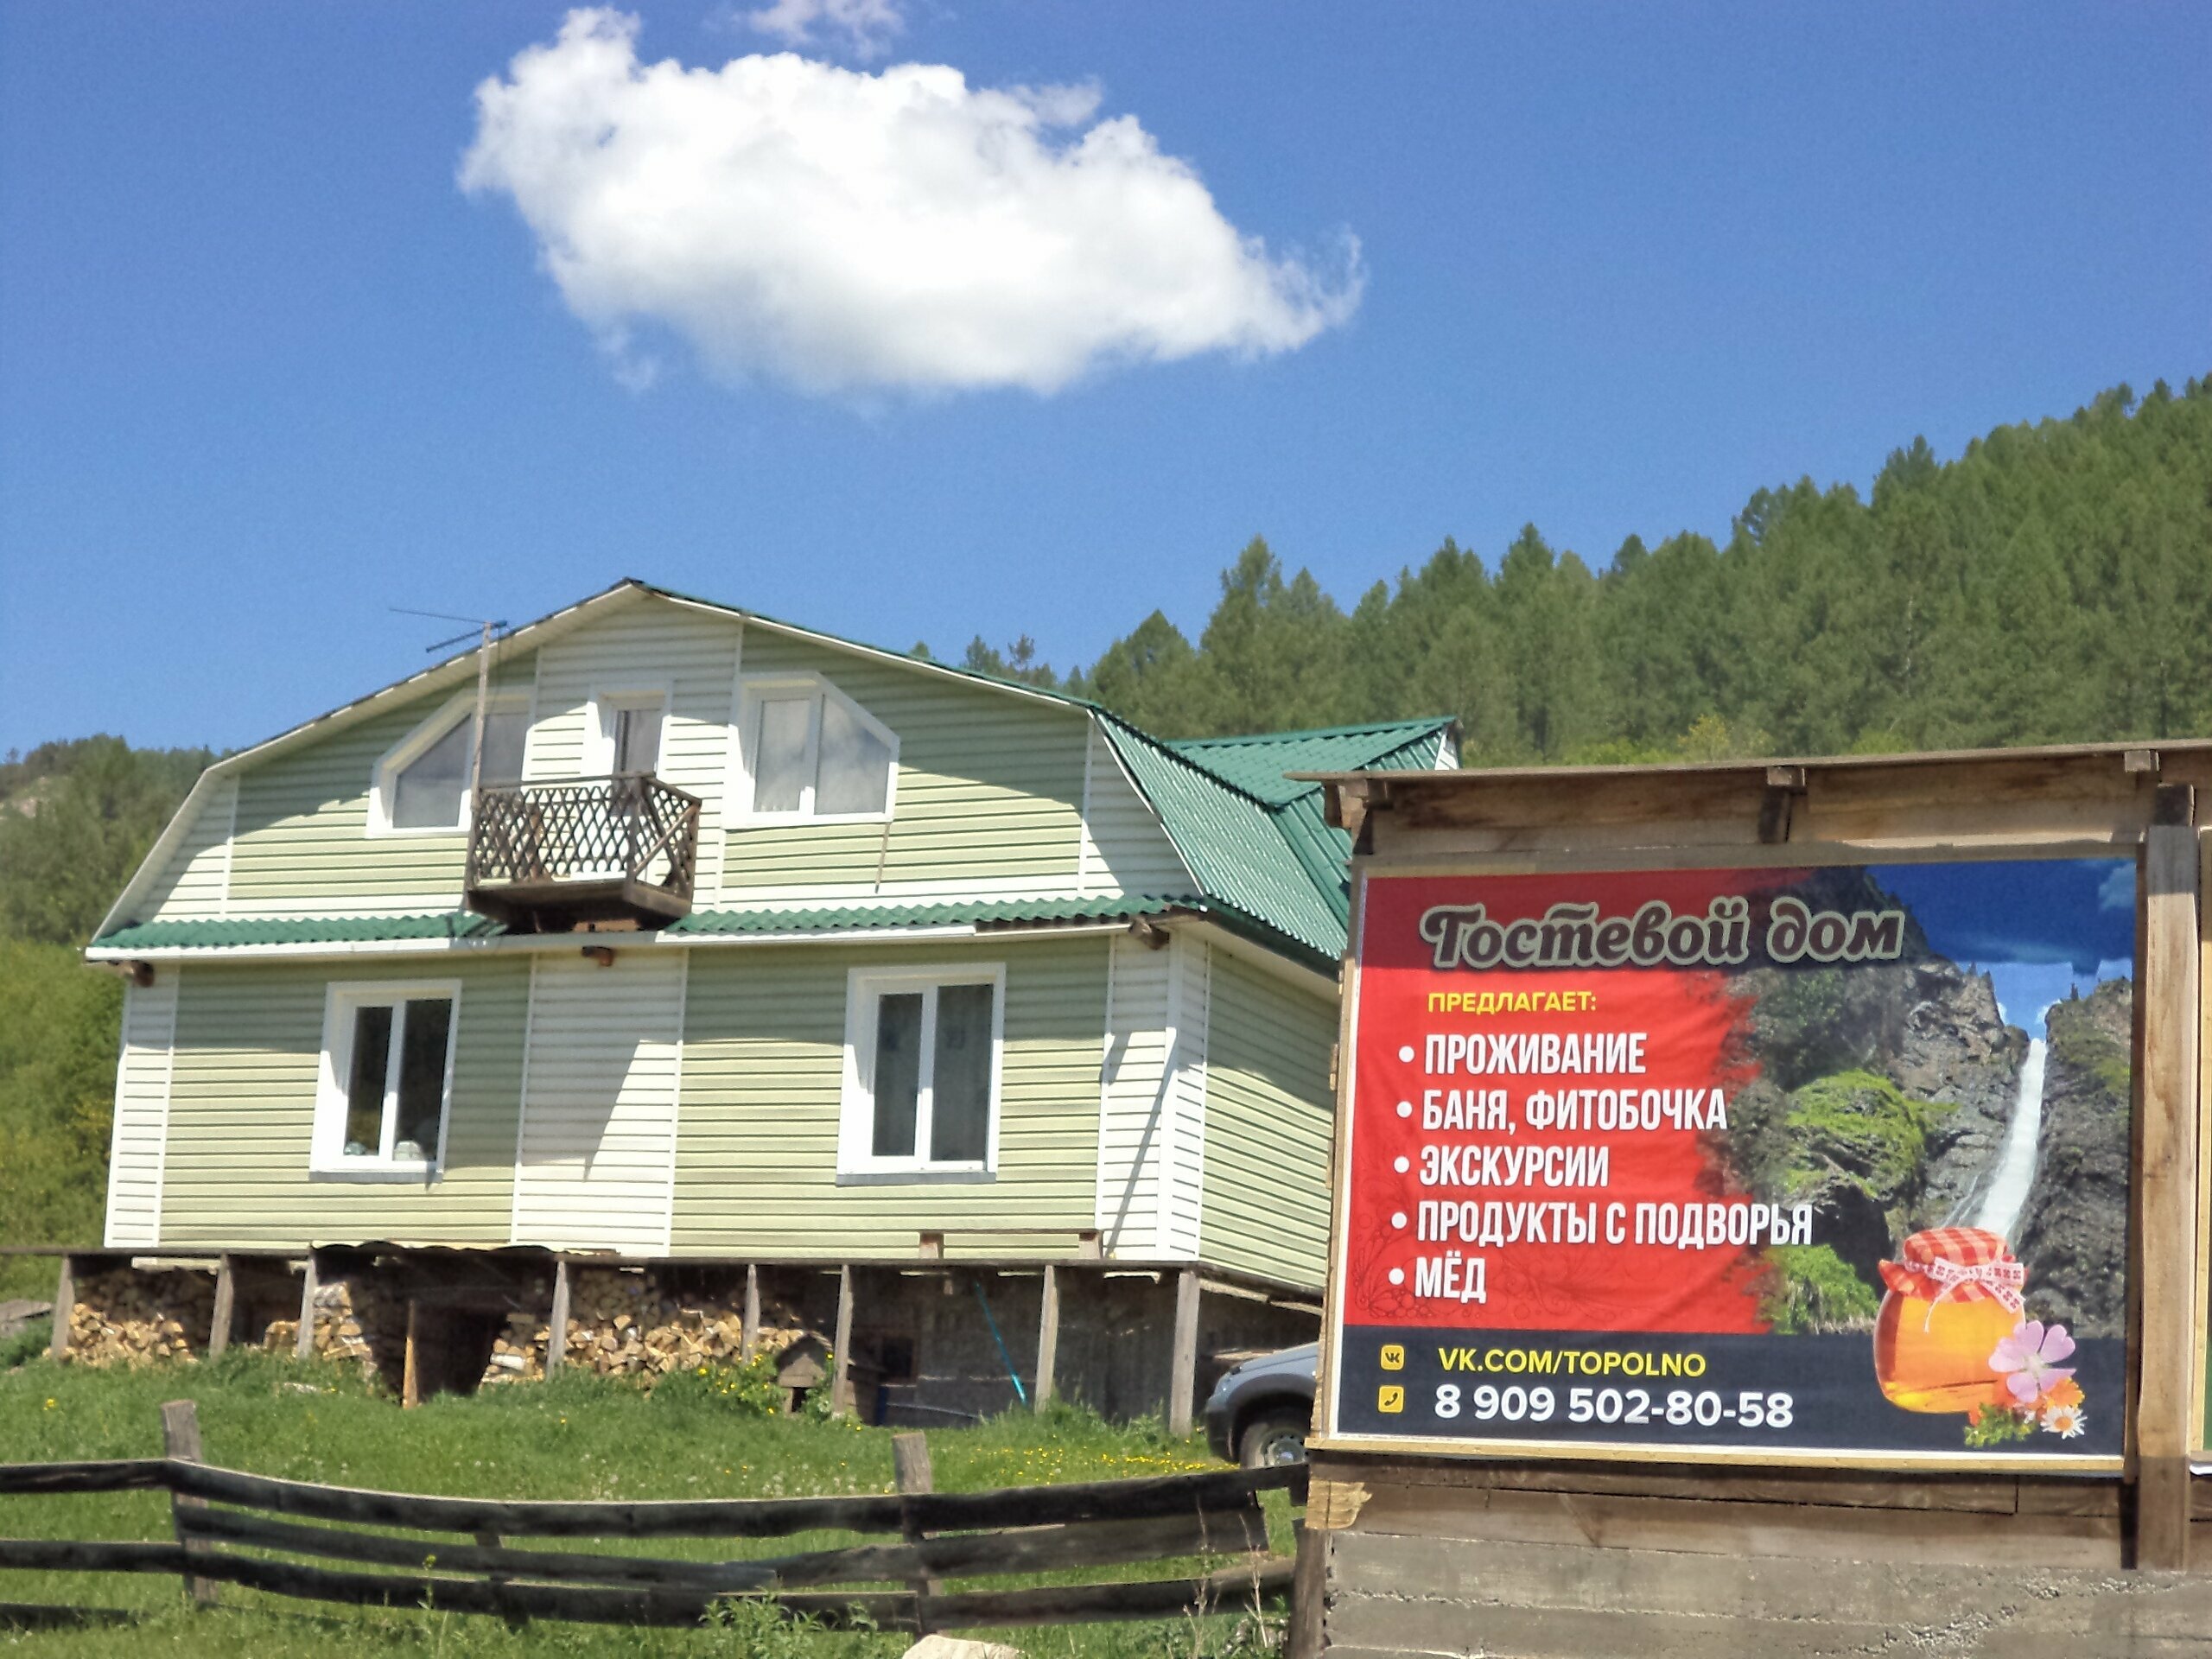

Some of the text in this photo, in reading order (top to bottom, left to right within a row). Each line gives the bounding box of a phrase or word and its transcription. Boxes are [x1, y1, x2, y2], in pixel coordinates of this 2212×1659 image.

[1420, 896, 1906, 969] Гостевой дом
[1427, 991, 1598, 1015] ПРЕДЛАГАЕТ:
[1425, 1033, 1647, 1075] ПРОЖИВАНИЕ
[1421, 1088, 1727, 1135] БАНЯ, ФИТОБОЧКА
[1419, 1146, 1610, 1187] ЭКСКУРСИИ
[1417, 1200, 1813, 1249] ПРОДУКТЫ С ПОДВОРЬЯ
[1414, 1250, 1487, 1303] МЁД
[1438, 1347, 1707, 1377] VK.COM/TOPOLNO
[1434, 1384, 1793, 1428] 8 909 502-80-58
